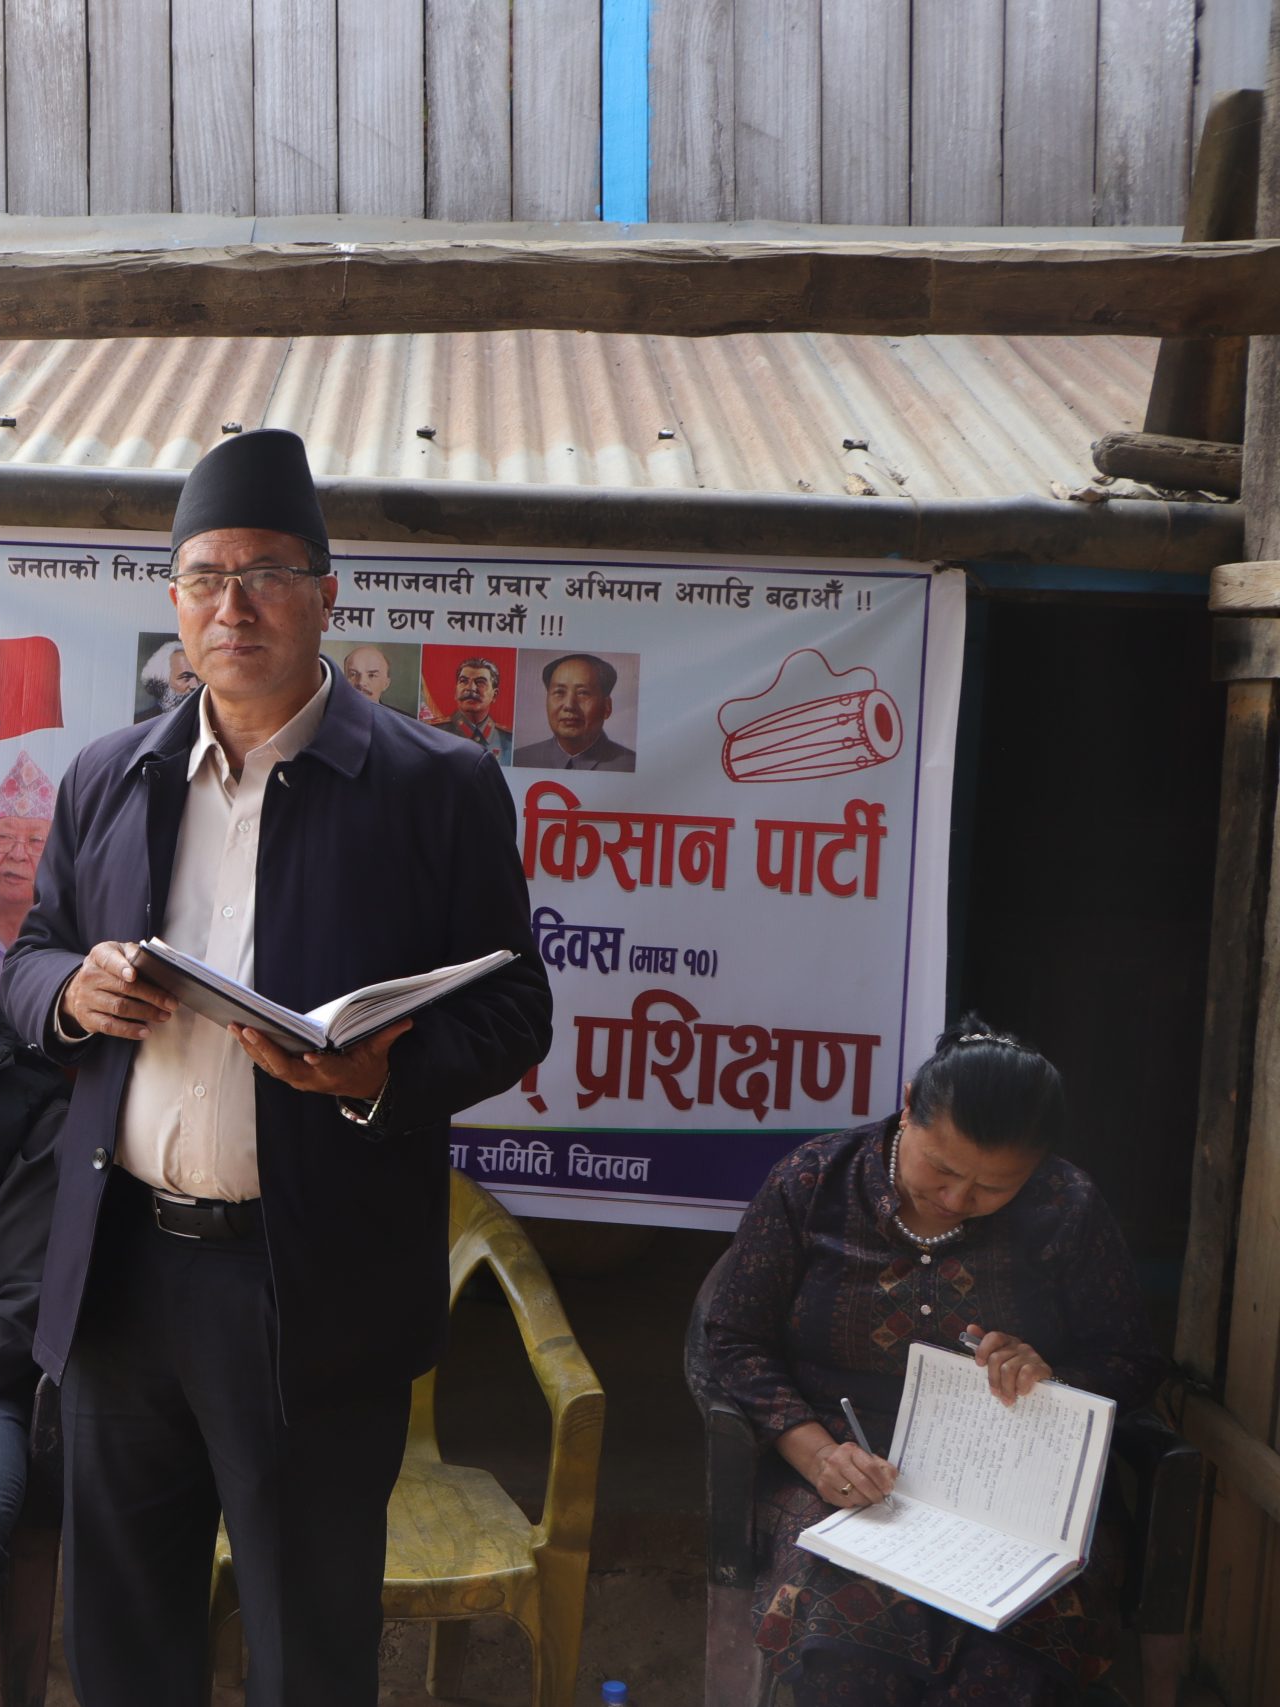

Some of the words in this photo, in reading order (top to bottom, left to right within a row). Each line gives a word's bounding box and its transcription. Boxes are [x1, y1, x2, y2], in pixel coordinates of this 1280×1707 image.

[8, 555, 99, 579] जनताको
[354, 568, 474, 594] समाजवादी
[487, 576, 551, 599] प्रचार
[566, 571, 661, 602] अभियान
[676, 577, 753, 608] अगाडि
[388, 609, 434, 630] छाप
[523, 780, 735, 891] किसान
[755, 799, 887, 898] पार्टी
[531, 906, 625, 974] दिवस
[629, 945, 678, 974] (माघ
[684, 949, 717, 977] १०)
[574, 989, 882, 1122] प्रशिक्षण
[569, 1144, 651, 1181] चितवन
